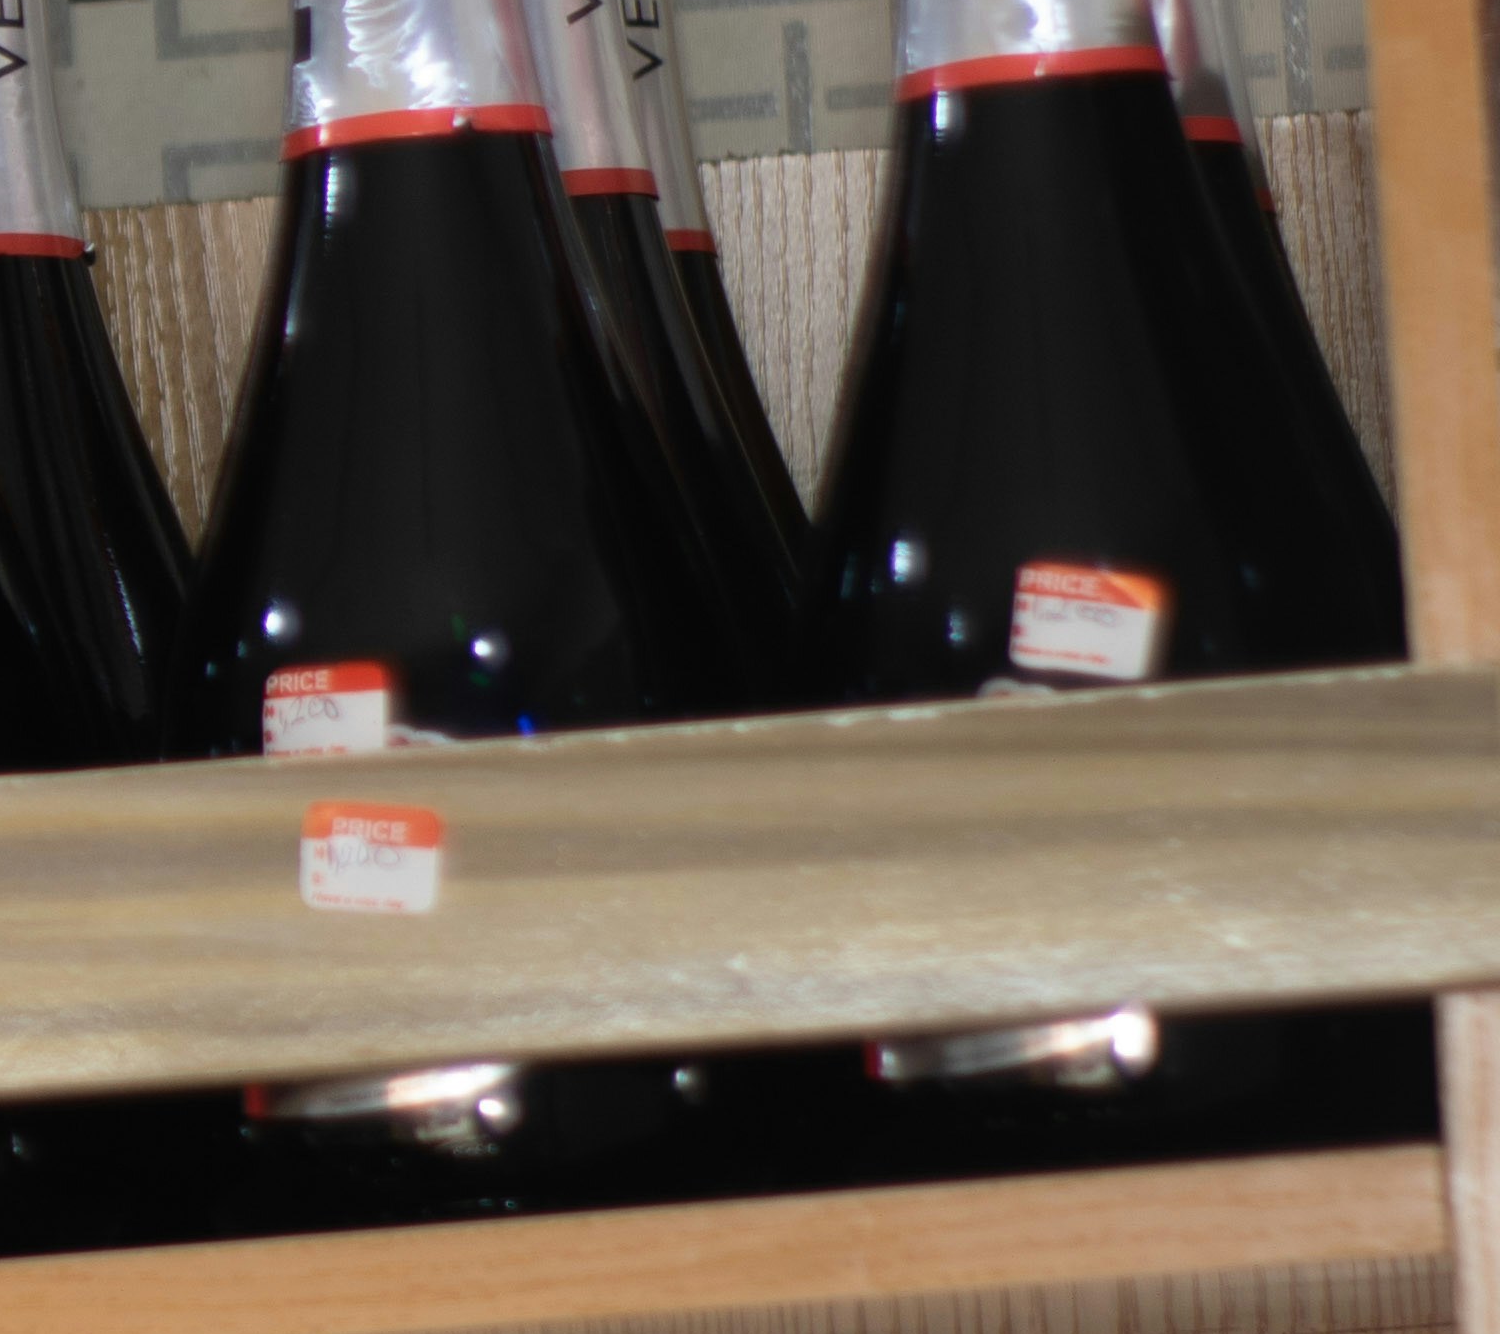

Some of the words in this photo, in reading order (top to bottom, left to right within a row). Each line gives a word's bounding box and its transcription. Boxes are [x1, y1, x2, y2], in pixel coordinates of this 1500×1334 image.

[1021, 568, 1098, 597] PRICE
[266, 668, 330, 695] PRICE
[332, 817, 407, 844] PRICE
